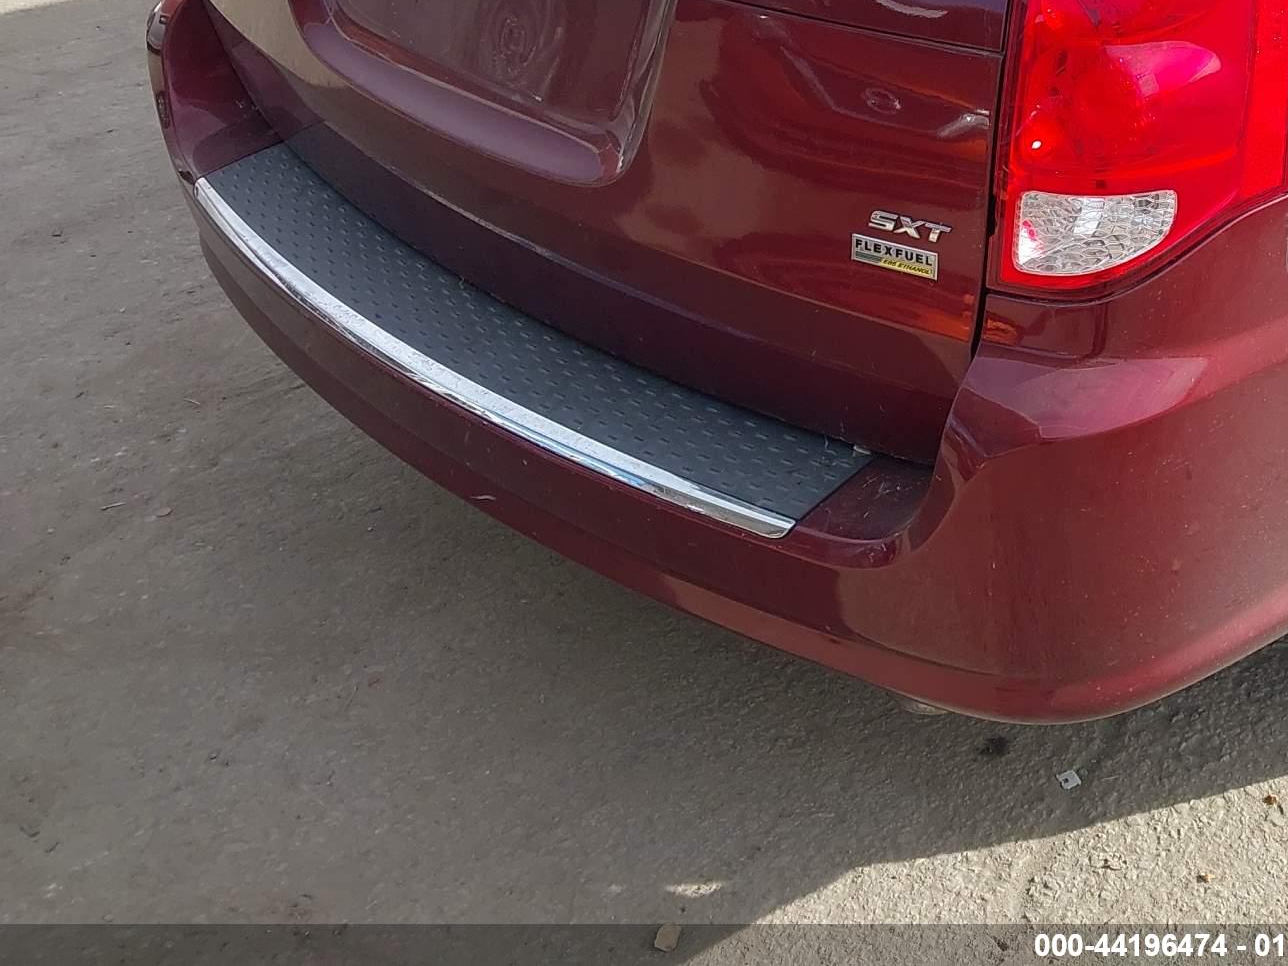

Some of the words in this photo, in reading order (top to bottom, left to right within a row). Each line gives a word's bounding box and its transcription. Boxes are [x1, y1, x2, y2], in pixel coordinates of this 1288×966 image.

[868, 210, 952, 242] SXT
[855, 238, 933, 266] FLEXFUEL
[898, 261, 931, 275] ETHANOL
